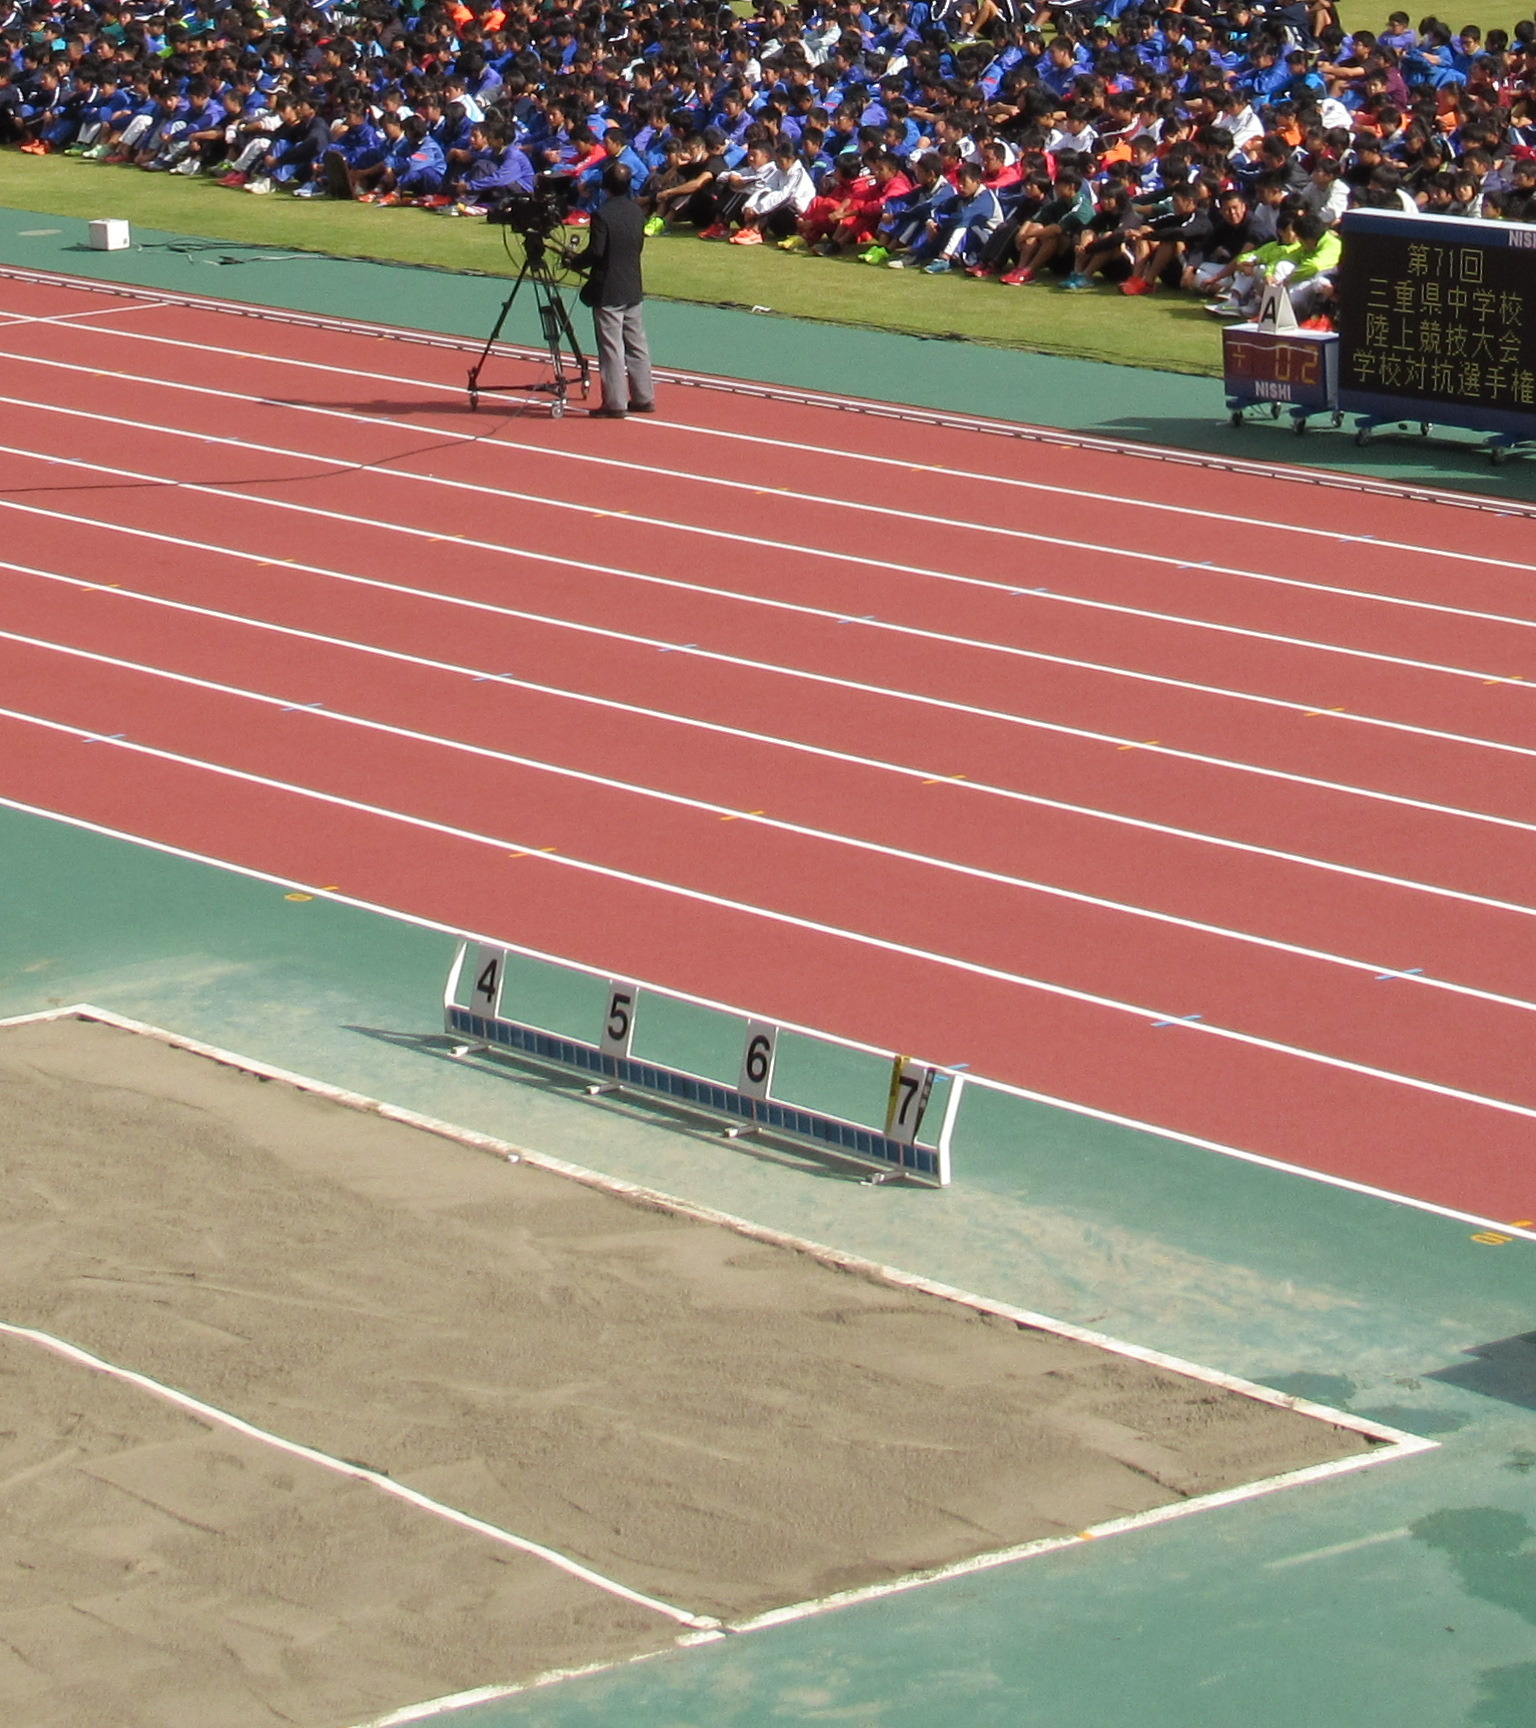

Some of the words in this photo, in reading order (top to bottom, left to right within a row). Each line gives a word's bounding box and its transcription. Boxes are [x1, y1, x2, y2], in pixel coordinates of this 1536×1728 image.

[1407, 243, 1484, 284] 第71回
[1261, 295, 1276, 324] A
[1367, 277, 1523, 327] 三重県中学校
[1365, 312, 1523, 364] 陸上競技大会
[1254, 380, 1292, 401] NISHI
[1352, 348, 1535, 405] 学校対抗選手権
[476, 957, 499, 1004] 4
[607, 992, 631, 1042] 5
[745, 1033, 771, 1084] 6
[898, 1075, 919, 1125] 7
